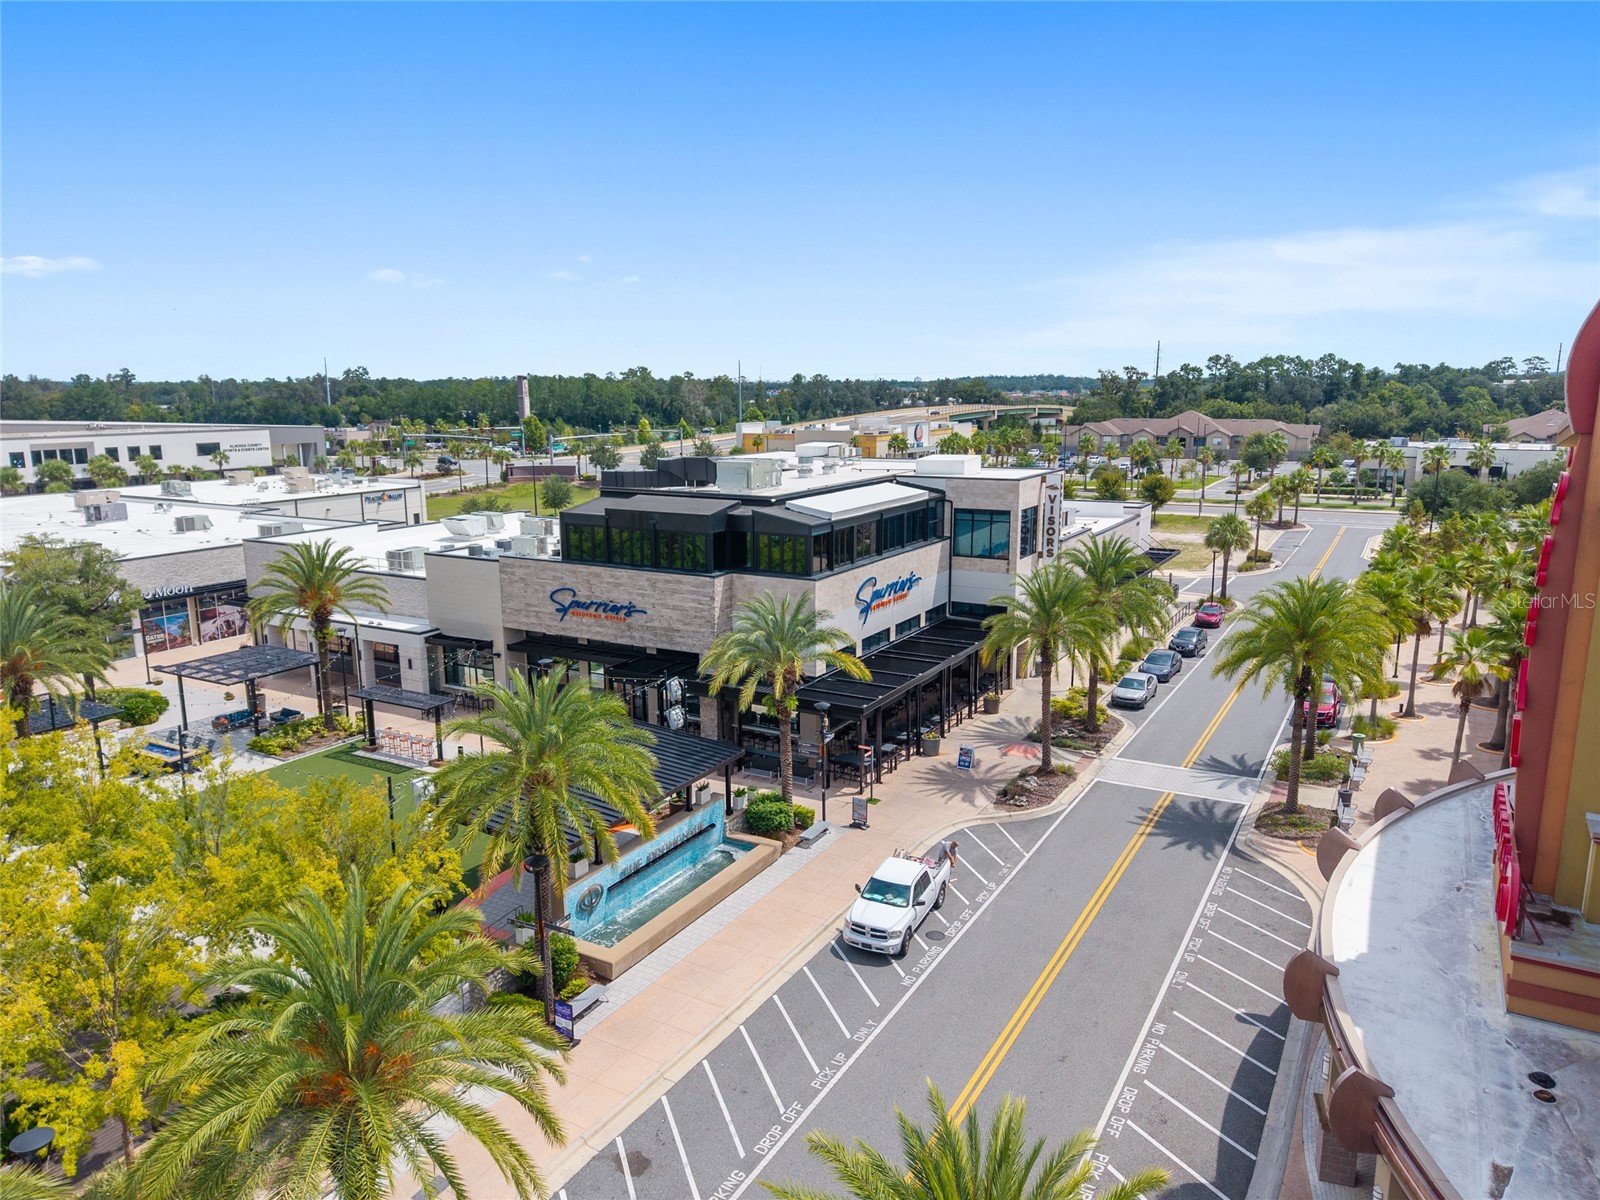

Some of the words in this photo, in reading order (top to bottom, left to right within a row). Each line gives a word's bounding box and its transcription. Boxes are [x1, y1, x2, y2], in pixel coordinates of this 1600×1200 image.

[1046, 494, 1058, 558] VISORS
[155, 584, 193, 598] Moon
[856, 571, 922, 625] Spurrier's
[549, 588, 647, 621] Spurrier's
[1212, 874, 1230, 896] PARKING
[1203, 901, 1218, 917] DROP
[1198, 917, 1211, 930] OFF
[900, 975, 916, 987] NO
[912, 945, 943, 973] PARKING
[944, 921, 963, 937] DROP
[960, 908, 974, 920] OFF
[1187, 937, 1203, 952] PICK
[1184, 952, 1196, 963] UP
[1171, 970, 1188, 990] ONLY
[1151, 1022, 1167, 1035] NO
[1133, 1037, 1160, 1075] PARKING
[753, 1124, 783, 1155] DROP
[781, 1101, 803, 1123] OFF
[810, 1066, 837, 1090] PICK
[831, 1052, 847, 1066] UP
[853, 1019, 878, 1042] ONLY
[1118, 1086, 1138, 1114] DROP
[1106, 1115, 1126, 1139] OFF
[1092, 1152, 1110, 1180] PICK
